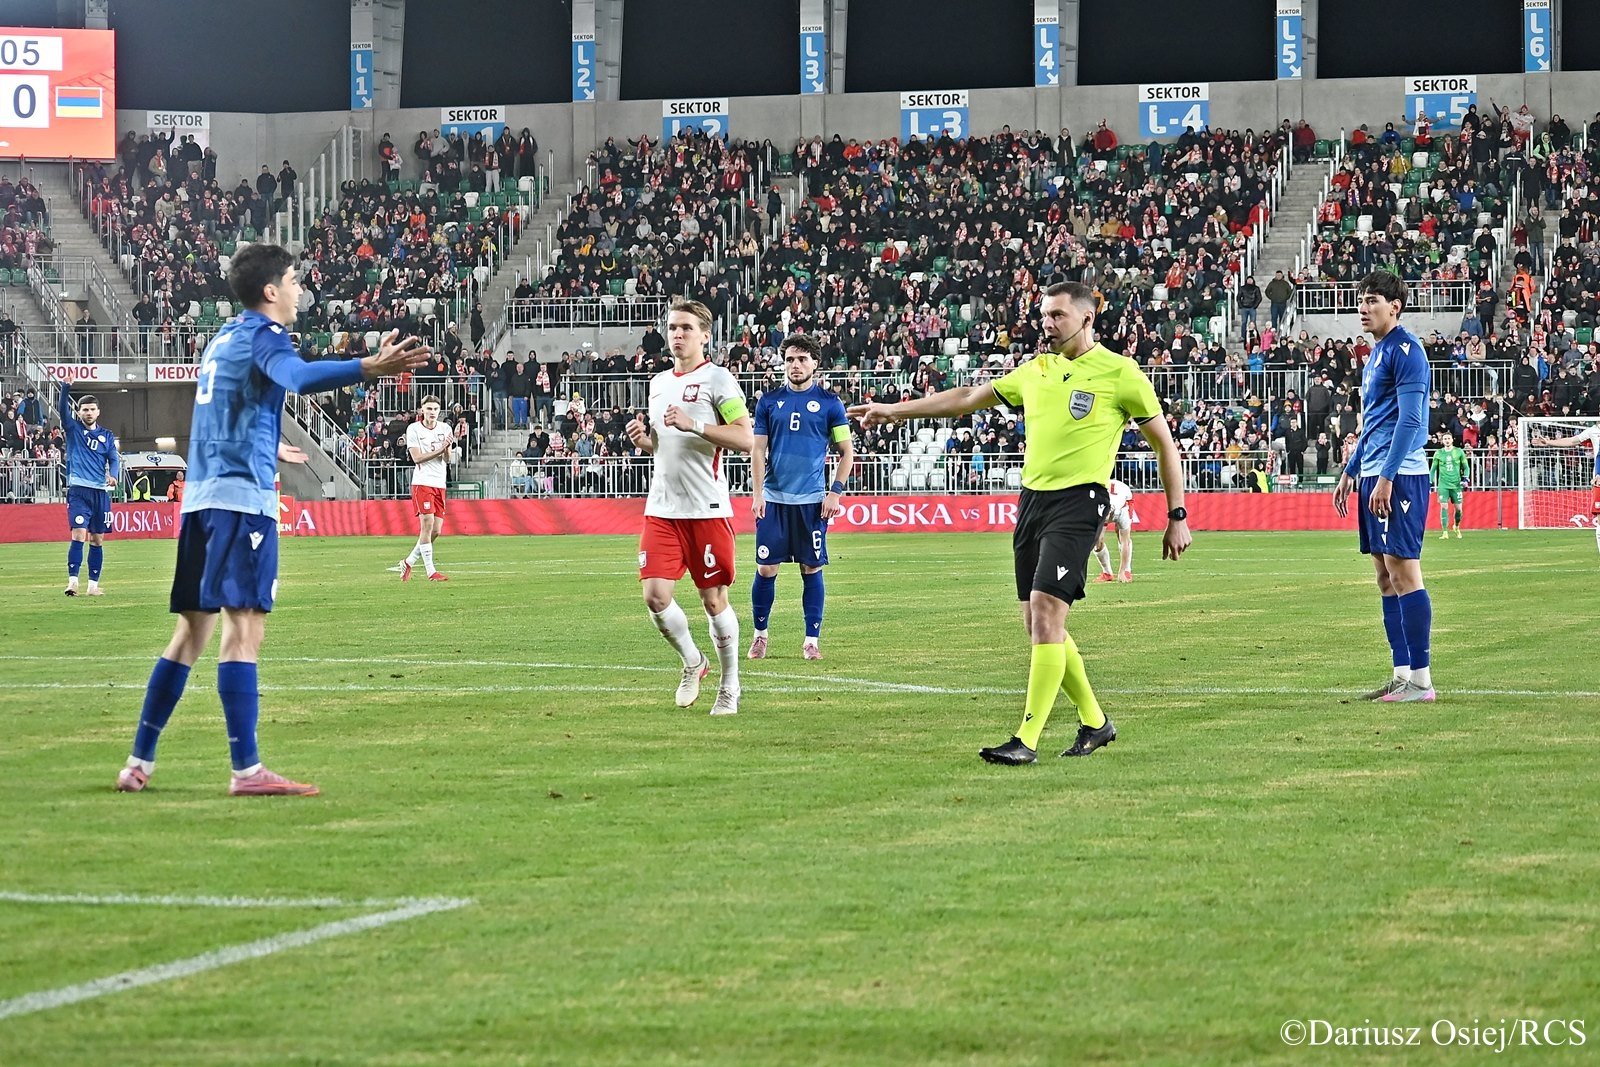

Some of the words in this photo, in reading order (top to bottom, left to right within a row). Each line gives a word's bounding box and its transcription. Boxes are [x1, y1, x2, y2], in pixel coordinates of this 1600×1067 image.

[0, 40, 40, 66] 05
[1147, 86, 1201, 99] SEKTOR
[1413, 79, 1468, 92] SEKTOR
[13, 84, 36, 119] 0
[670, 101, 721, 114] SEKTOR
[908, 94, 960, 107] SEKTOR
[153, 114, 203, 127] SEKTOR
[448, 109, 497, 121] SEKTOR
[1149, 104, 1204, 134] L-4
[47, 366, 98, 379] POMOC
[195, 332, 233, 405] 5
[789, 412, 801, 431] 6
[86, 436, 99, 451] 10
[827, 503, 953, 526] POLSKA
[812, 530, 822, 549] 6
[703, 543, 716, 569] 6
